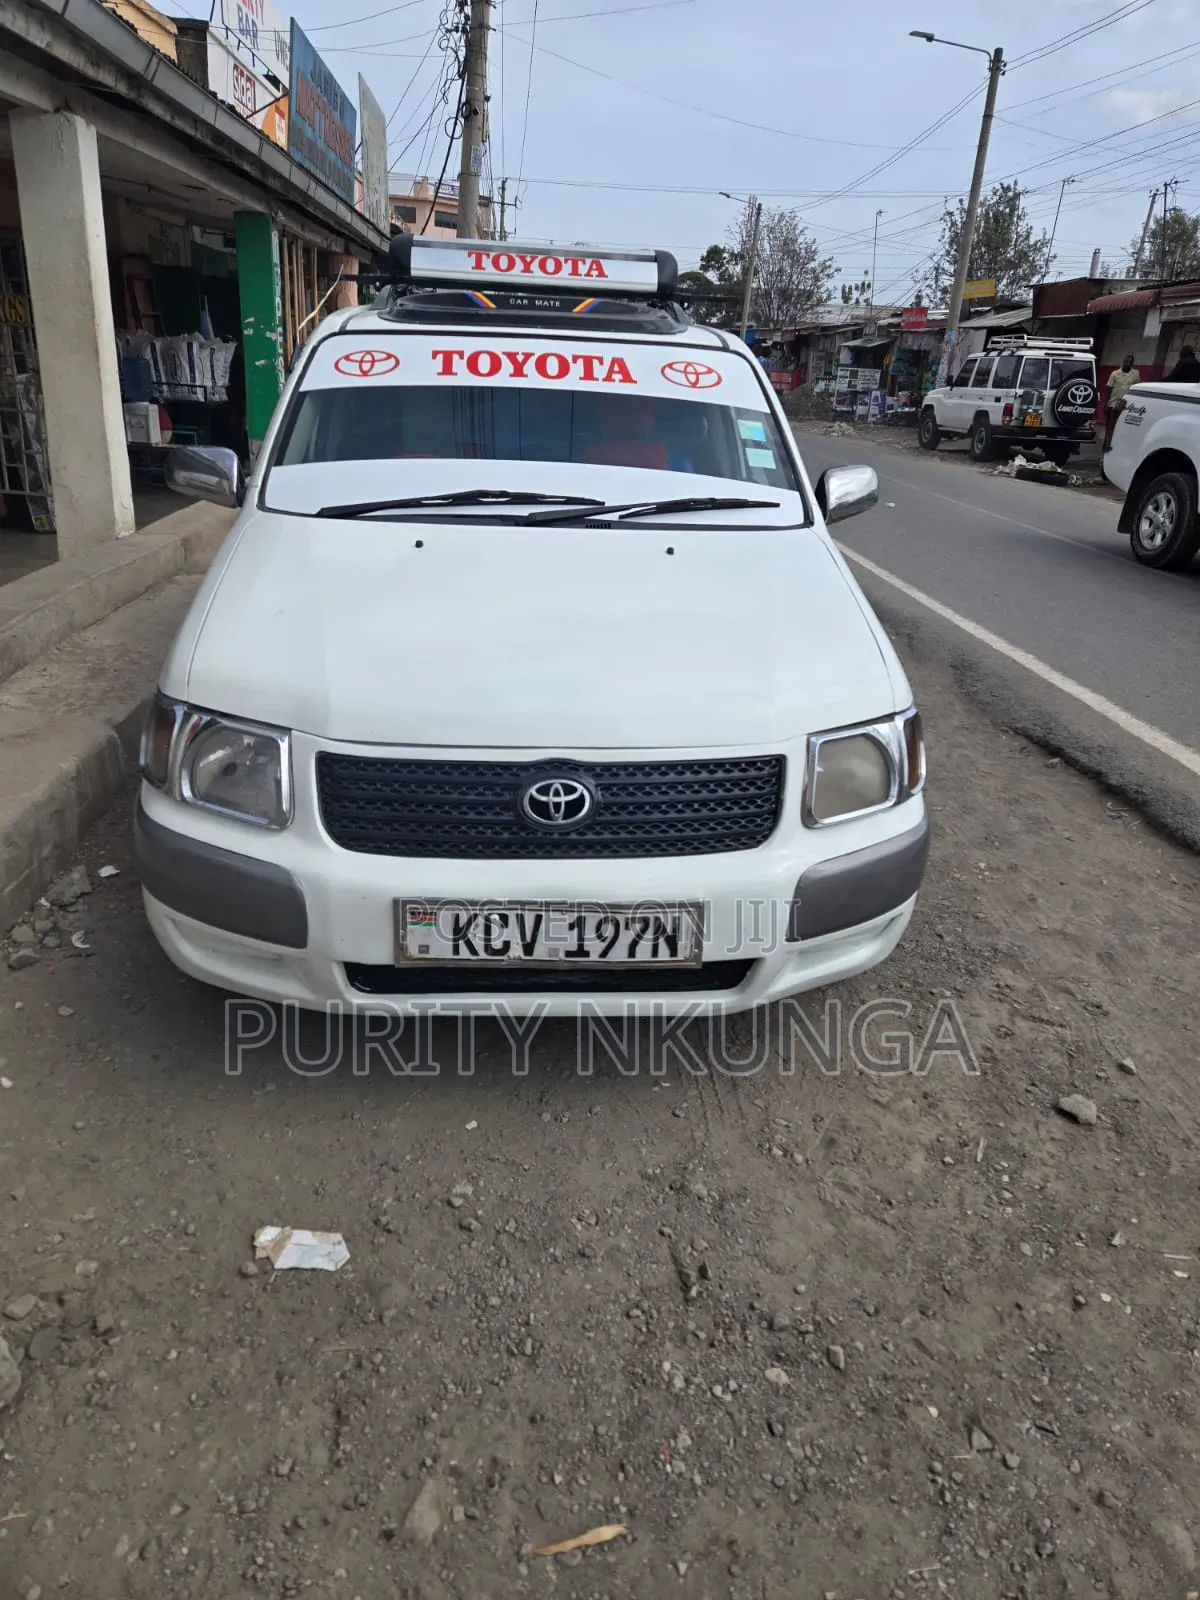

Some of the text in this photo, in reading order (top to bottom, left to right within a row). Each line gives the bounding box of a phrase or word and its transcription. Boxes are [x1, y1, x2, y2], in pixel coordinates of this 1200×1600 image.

[237, 3, 259, 51] BAR
[468, 251, 608, 278] TOYOTA
[535, 300, 561, 308] MATE
[432, 350, 637, 384] TOYOTA
[452, 912, 682, 958] KCV 197N
